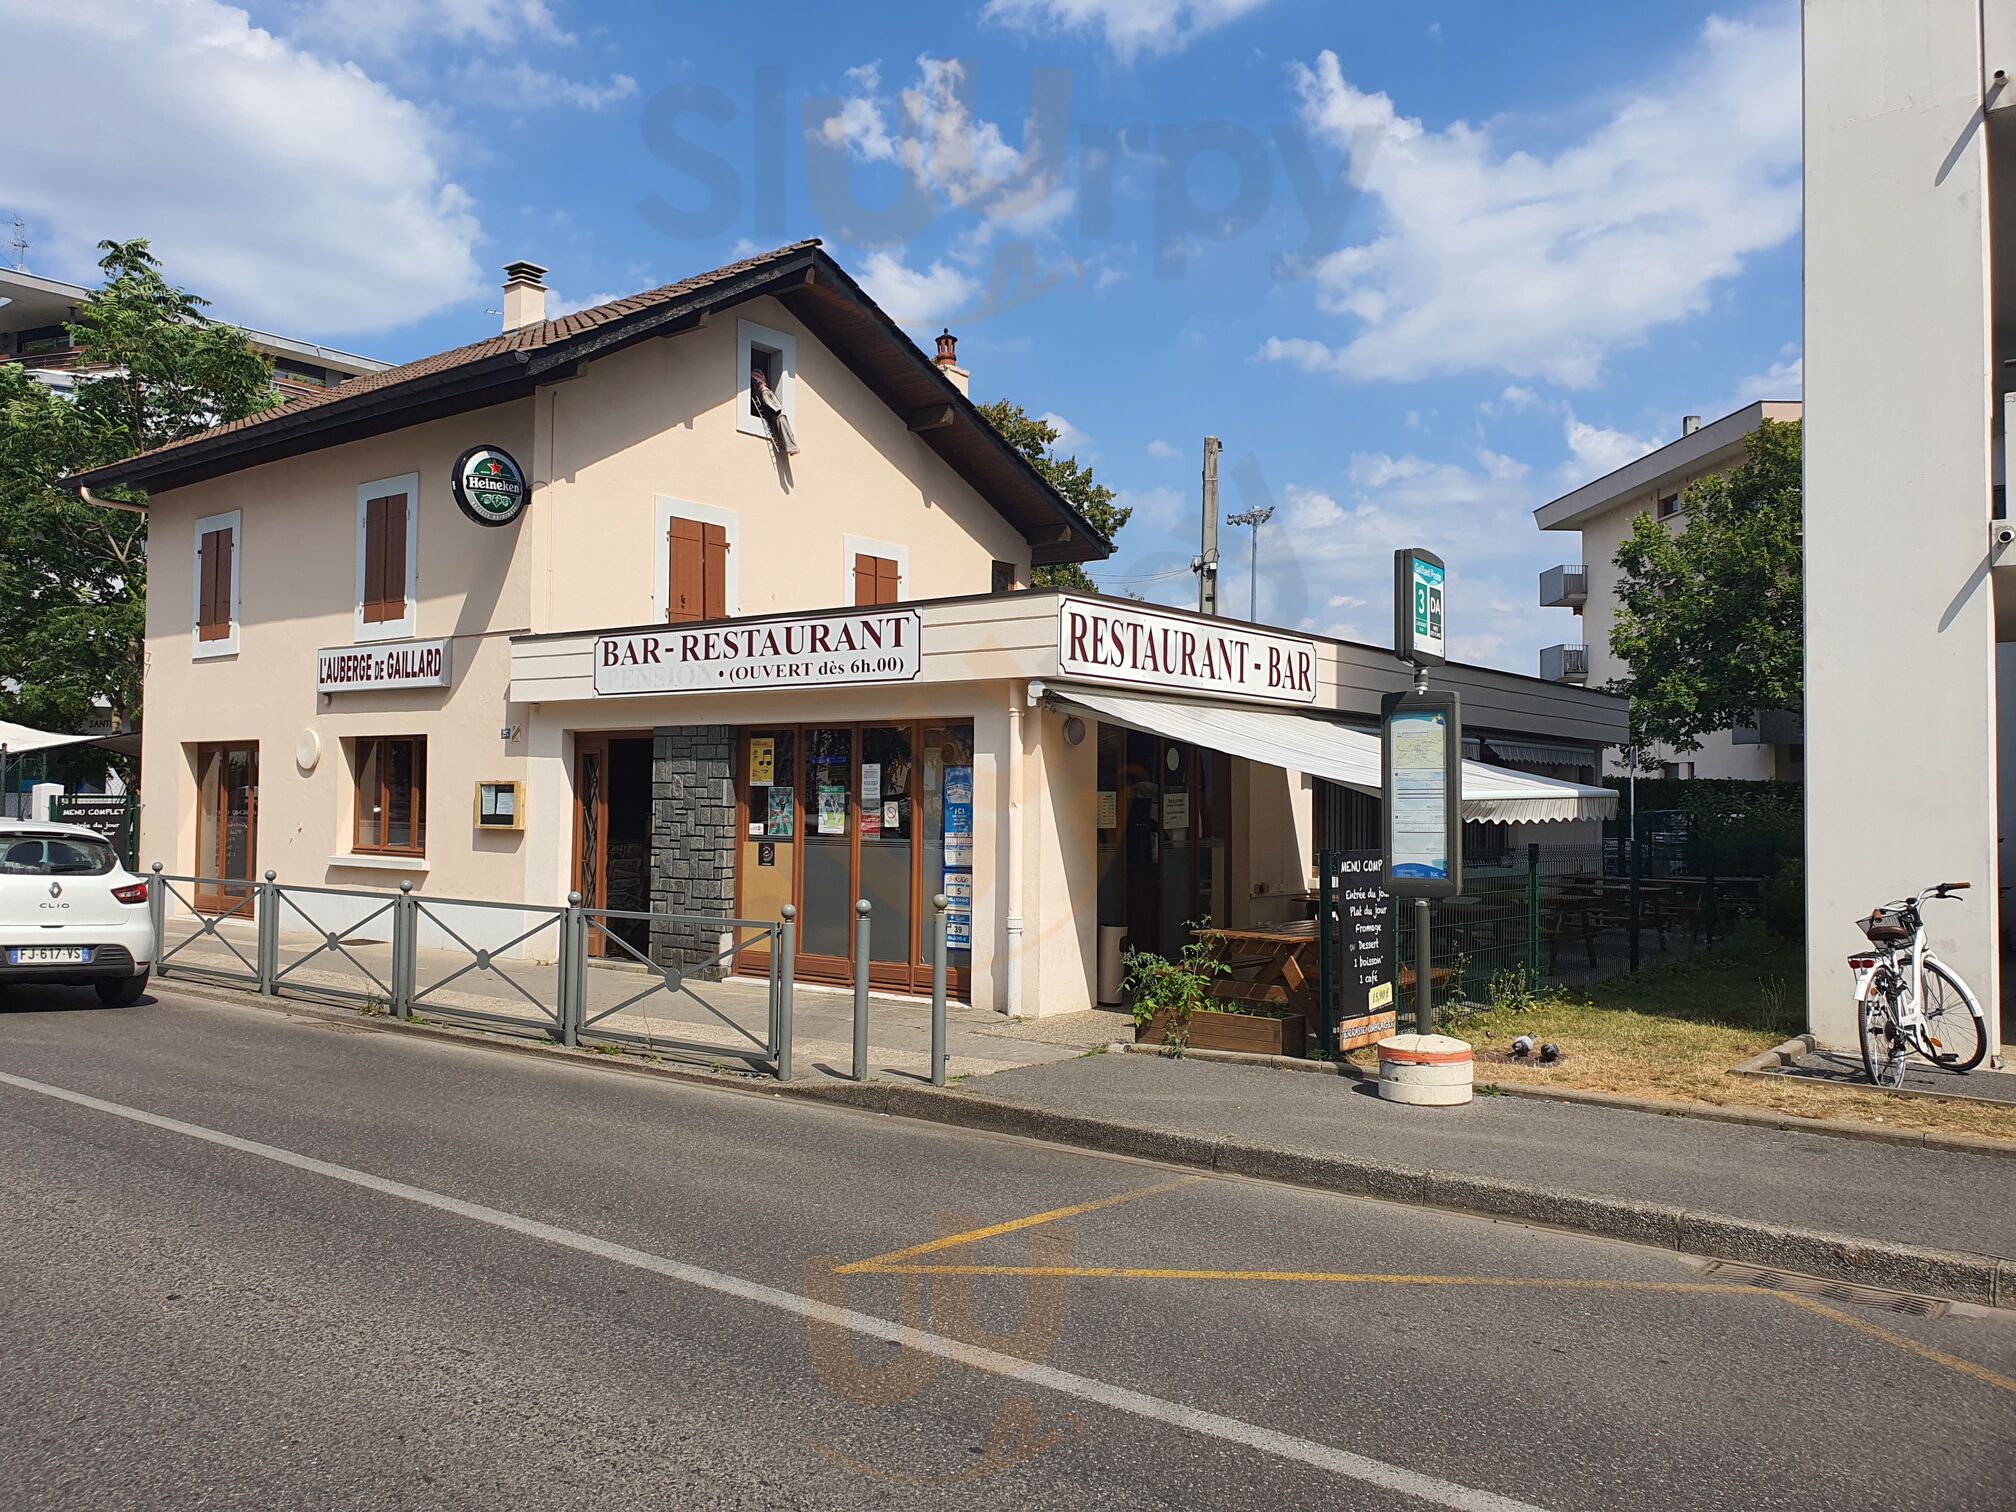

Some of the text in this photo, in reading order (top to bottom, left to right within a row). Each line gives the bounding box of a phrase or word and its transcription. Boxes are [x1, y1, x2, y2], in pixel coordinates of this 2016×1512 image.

[469, 476, 520, 494] Heineken
[1418, 589, 1425, 614] 3
[1430, 596, 1441, 616] DA
[319, 648, 441, 684] L'AUBERGE DE GAILLARD
[818, 661, 845, 676] dès
[850, 656, 904, 674] 6h.00)
[63, 808, 125, 816] MENU COMPLET
[954, 807, 965, 815] ICI
[104, 822, 120, 831] jour
[1341, 859, 1383, 873] MENU COMP
[957, 887, 962, 895] 5
[1345, 886, 1390, 902] Entrée du jo
[1349, 903, 1388, 919] Plat du jour
[954, 926, 962, 934] 39
[1355, 923, 1382, 935] Fromage
[1358, 938, 1379, 950] Dessert
[20, 947, 81, 960] FJ-617-VS
[1353, 958, 1358, 968] 1
[1359, 969, 1378, 985] 1 café
